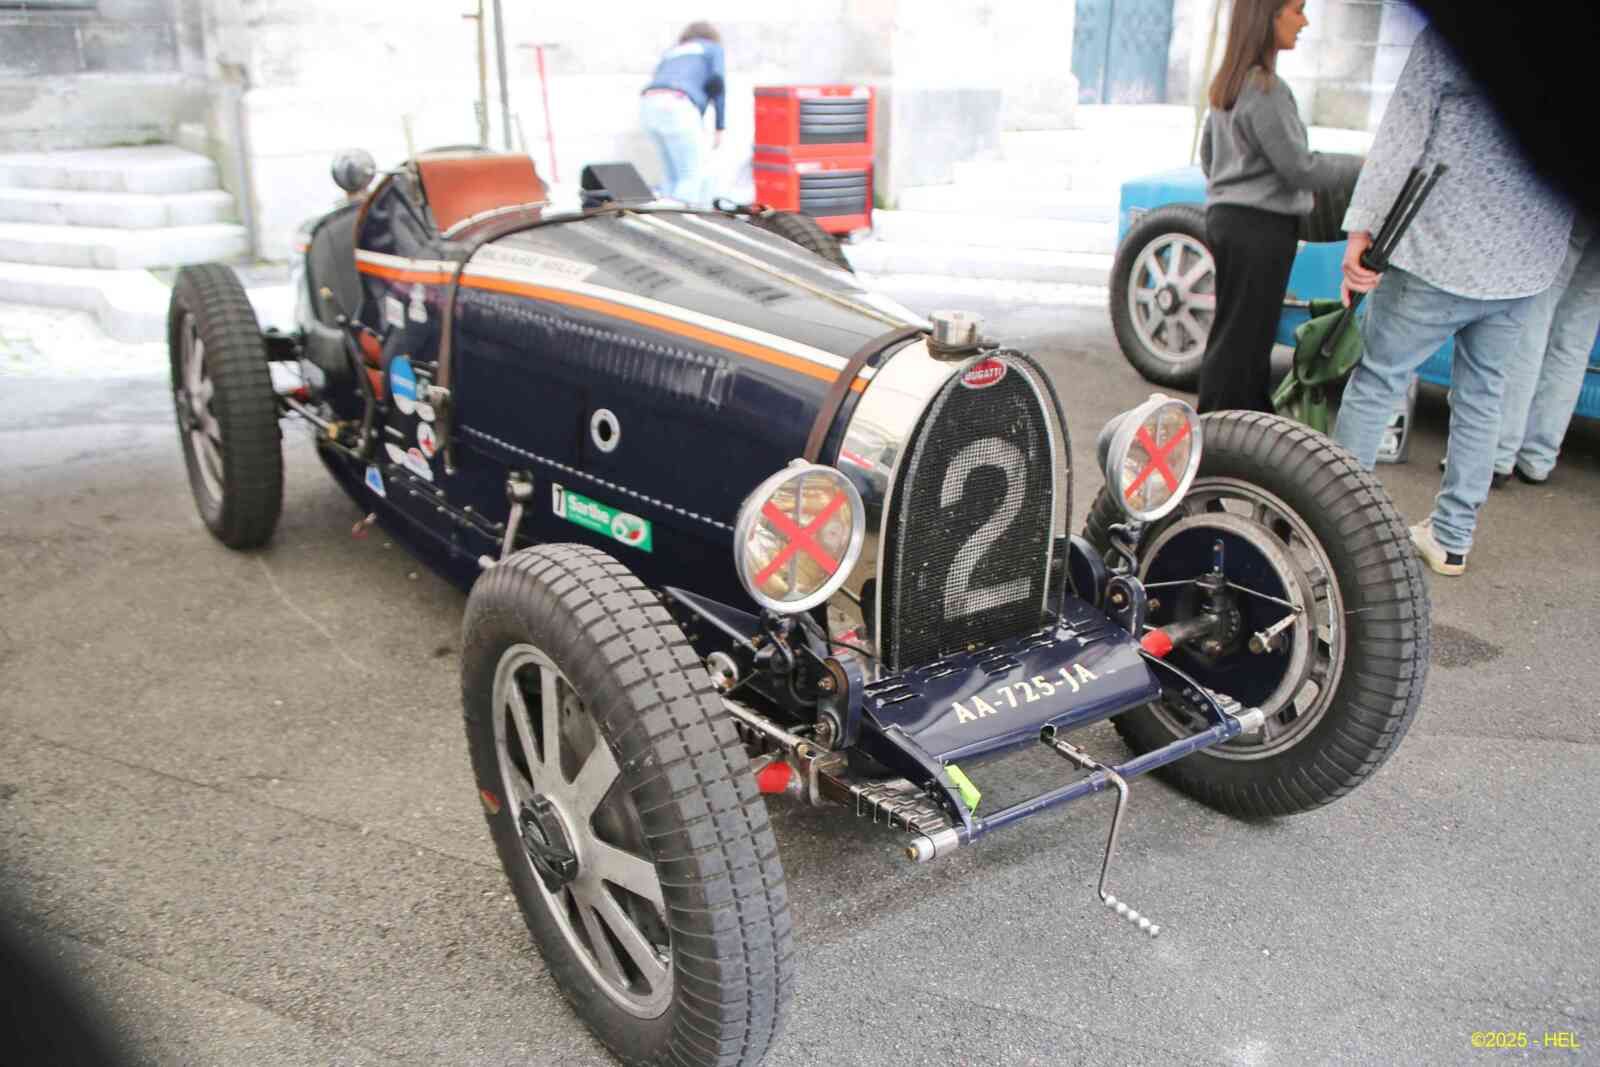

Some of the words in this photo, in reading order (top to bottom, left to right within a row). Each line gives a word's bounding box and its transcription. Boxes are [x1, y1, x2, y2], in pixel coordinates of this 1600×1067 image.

[964, 367, 1002, 381] BUGATTI
[940, 436, 1031, 620] 2
[951, 663, 1099, 724] AA-725-JA
